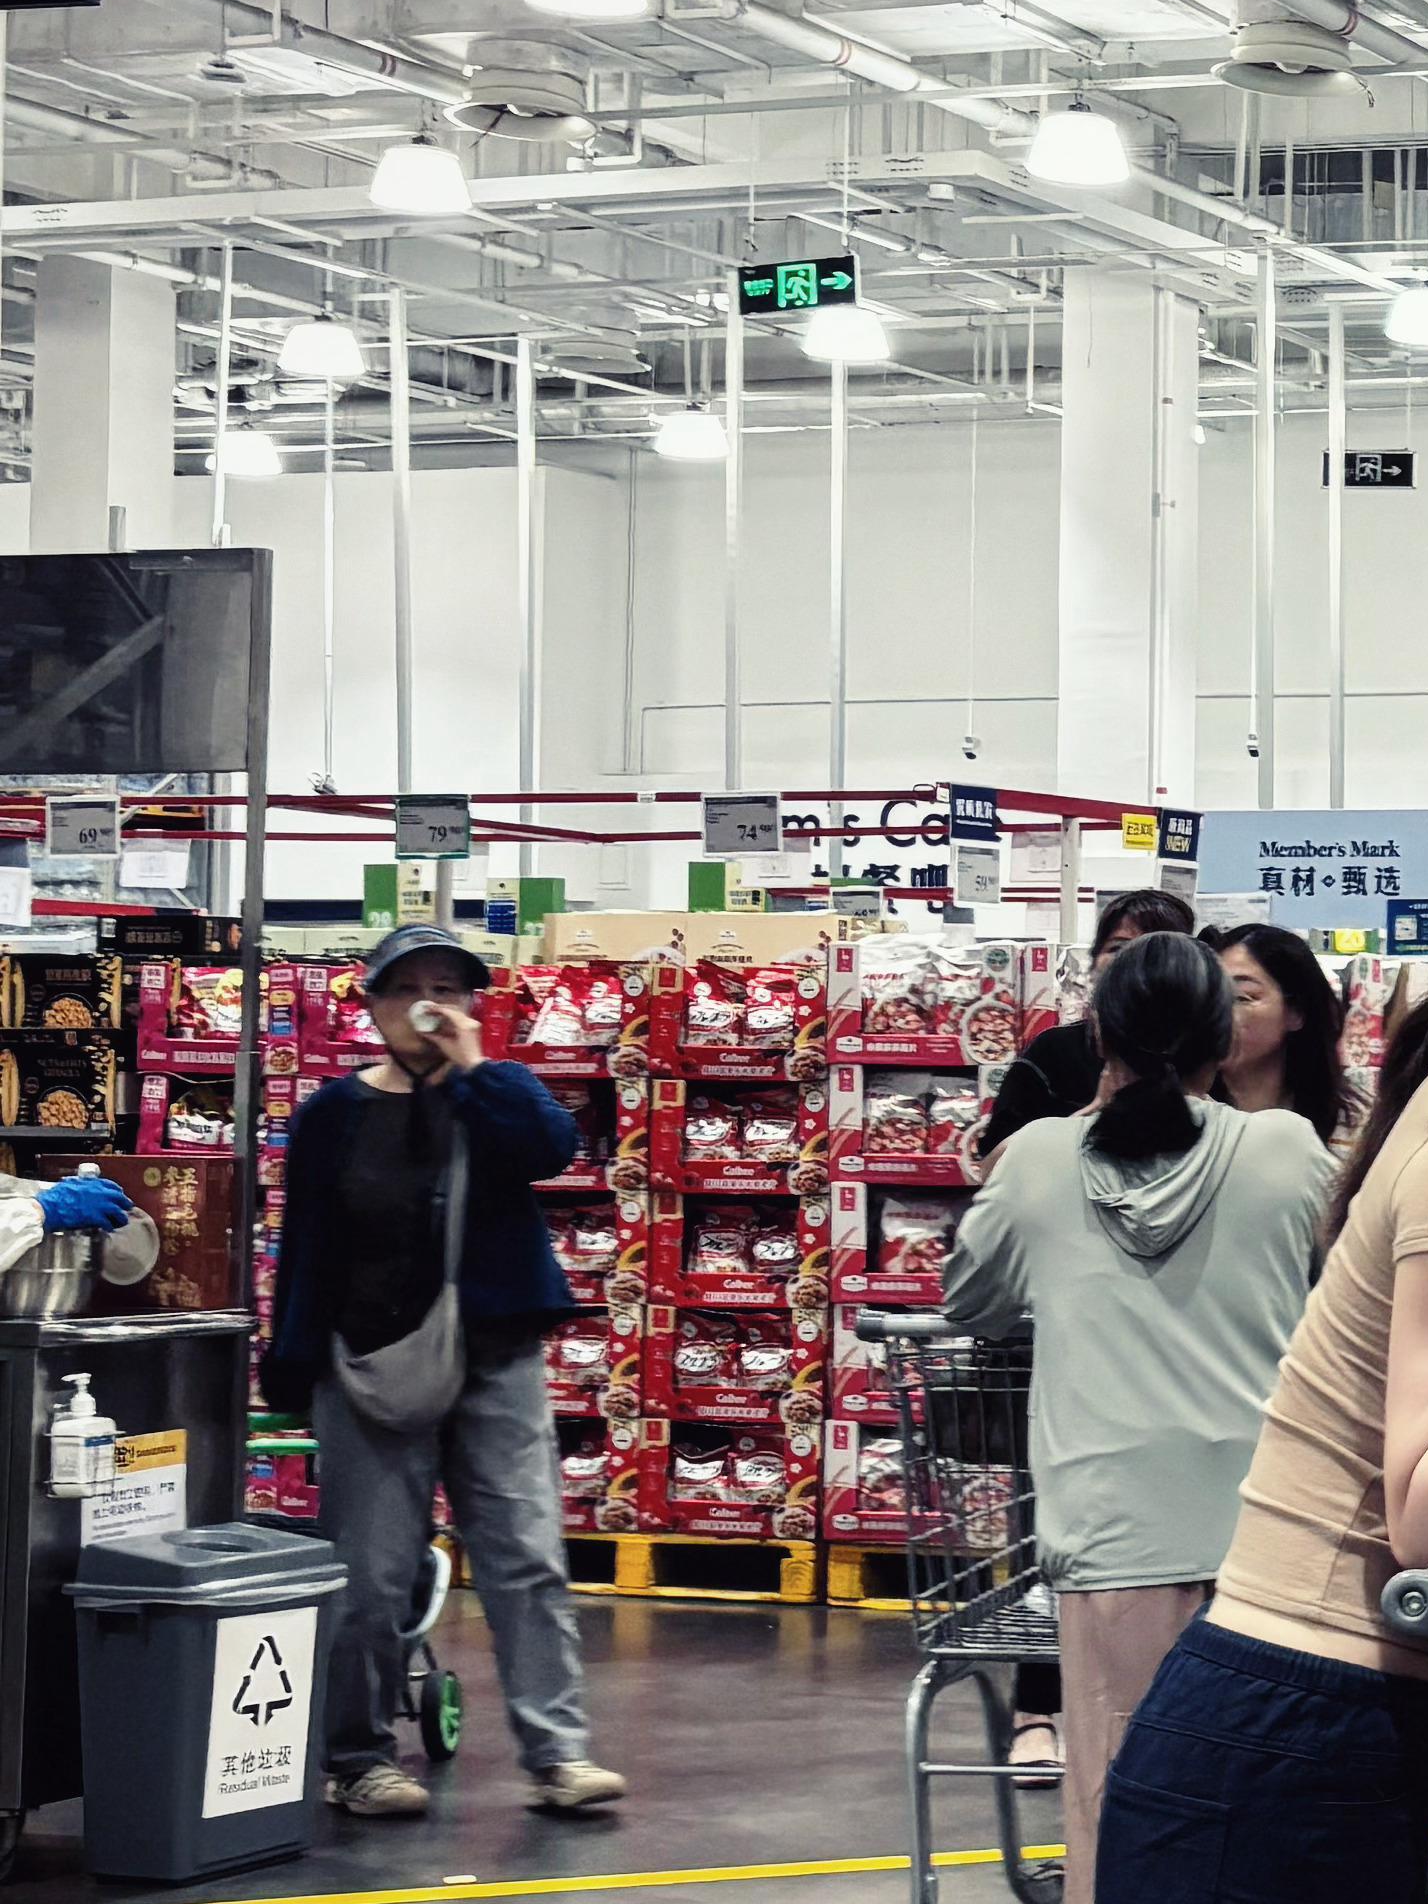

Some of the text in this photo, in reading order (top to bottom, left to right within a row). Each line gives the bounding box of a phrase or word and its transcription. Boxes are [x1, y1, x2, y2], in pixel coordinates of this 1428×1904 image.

[79, 828, 97, 844] 69
[428, 826, 447, 842] 79
[1165, 835, 1191, 853] NEW
[1259, 840, 1400, 858] Member's Mark
[1257, 865, 1400, 896] 真材 甄选
[221, 1746, 292, 1777] 其他垃圾
